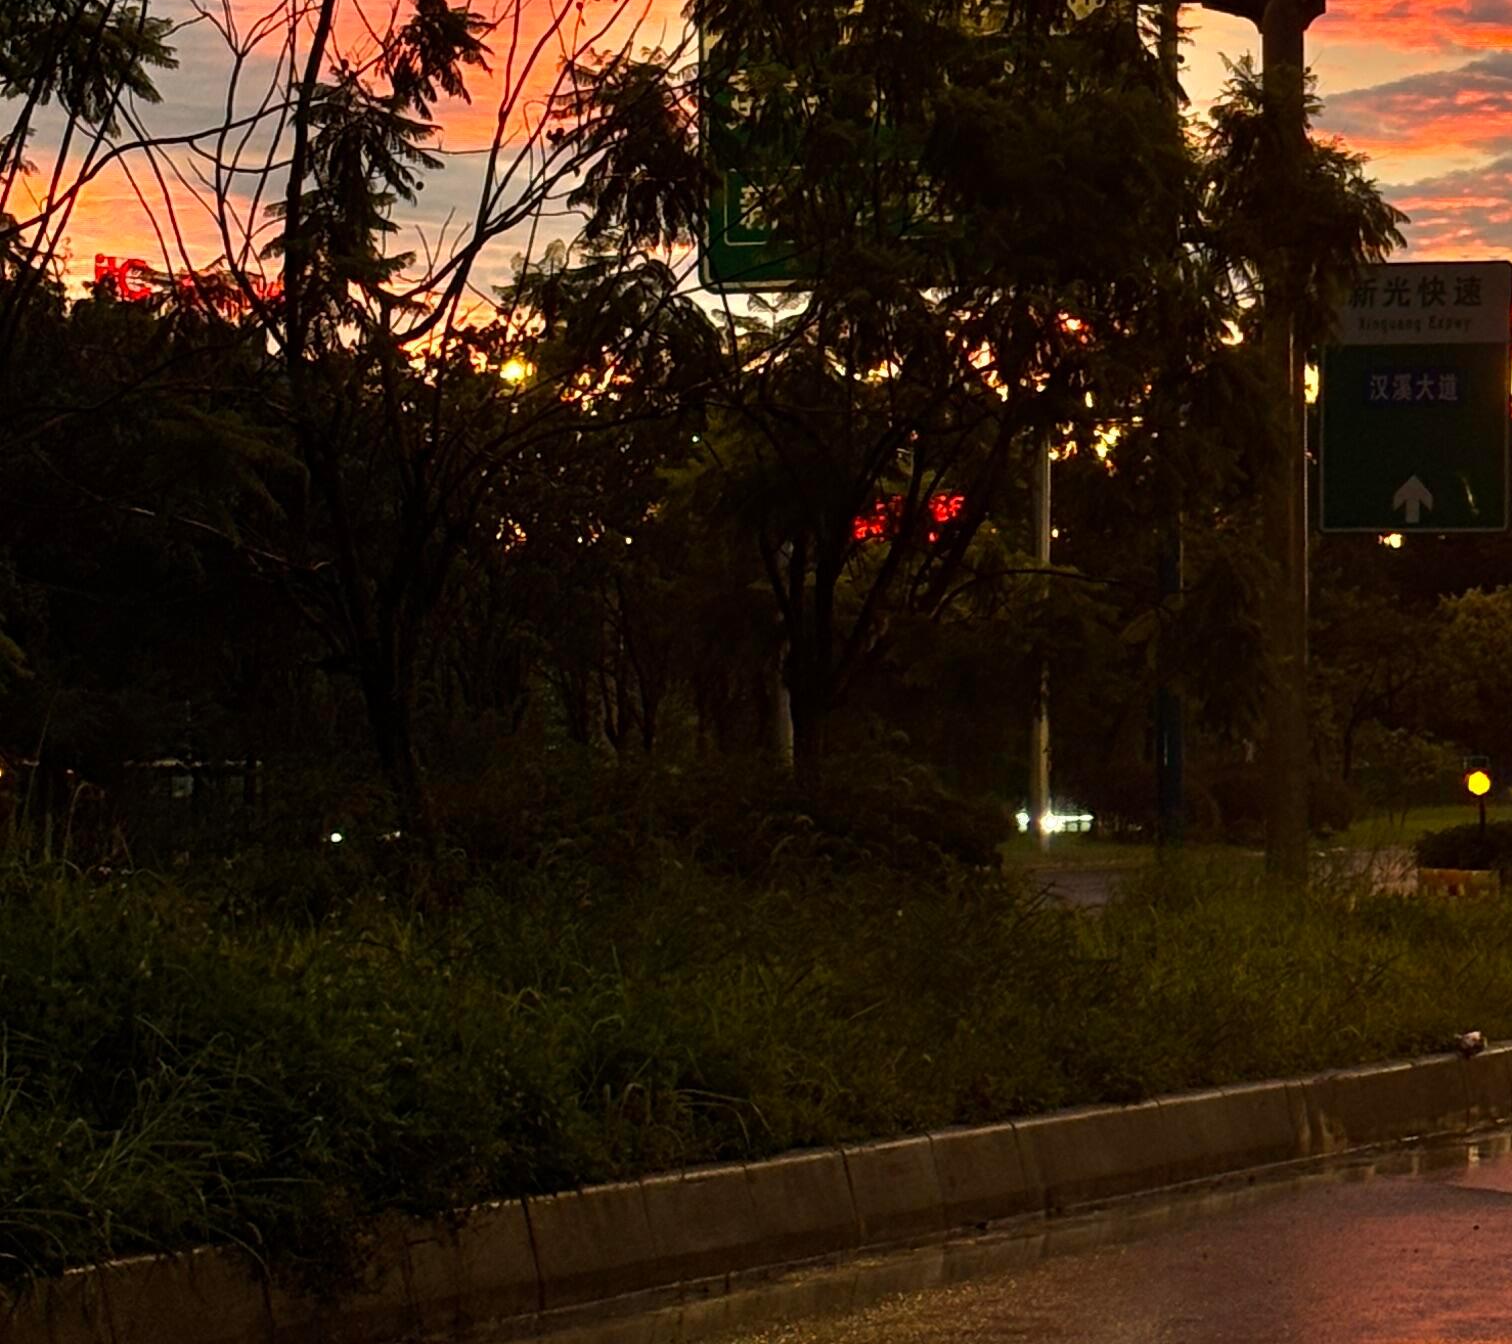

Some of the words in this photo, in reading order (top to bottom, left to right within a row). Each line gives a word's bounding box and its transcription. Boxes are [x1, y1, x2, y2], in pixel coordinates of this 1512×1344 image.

[1349, 275, 1481, 308] 新光快速
[1370, 373, 1458, 400] 汉溪大道
